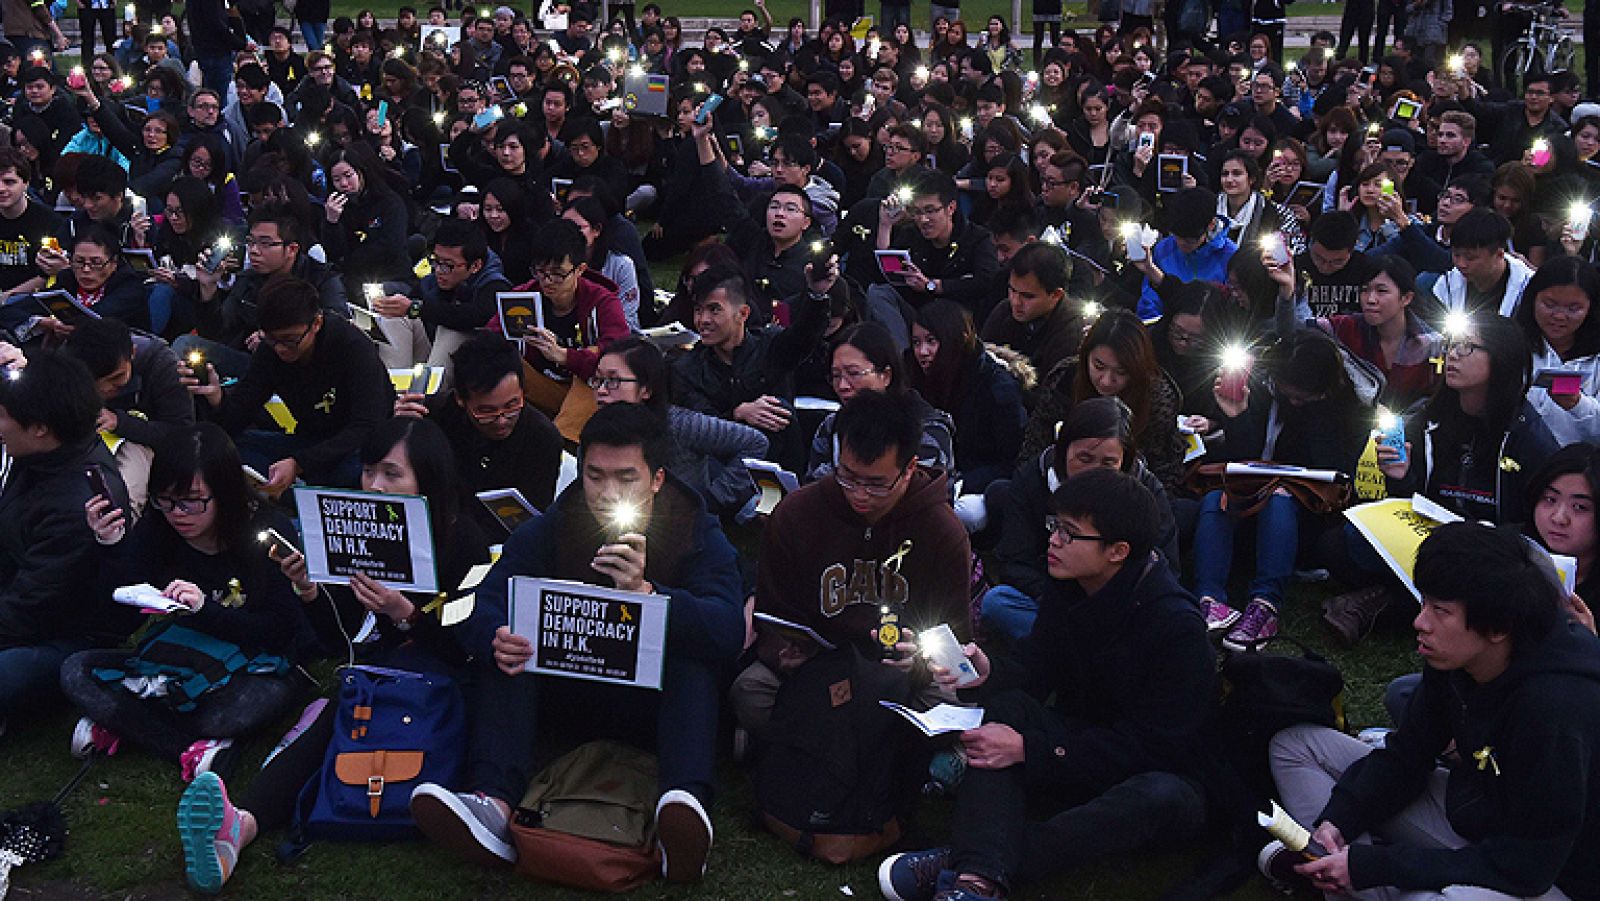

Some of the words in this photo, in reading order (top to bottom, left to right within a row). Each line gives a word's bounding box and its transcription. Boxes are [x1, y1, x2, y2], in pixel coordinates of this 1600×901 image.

[322, 498, 377, 520] SUPPORT
[325, 517, 404, 542] DEMOCRACY
[327, 535, 342, 553] IN
[345, 537, 373, 557] H.K.
[544, 594, 609, 620] SUPPORT
[543, 613, 636, 642] DEMOCRACY
[543, 631, 559, 648] IN
[564, 634, 592, 654] H.K.
